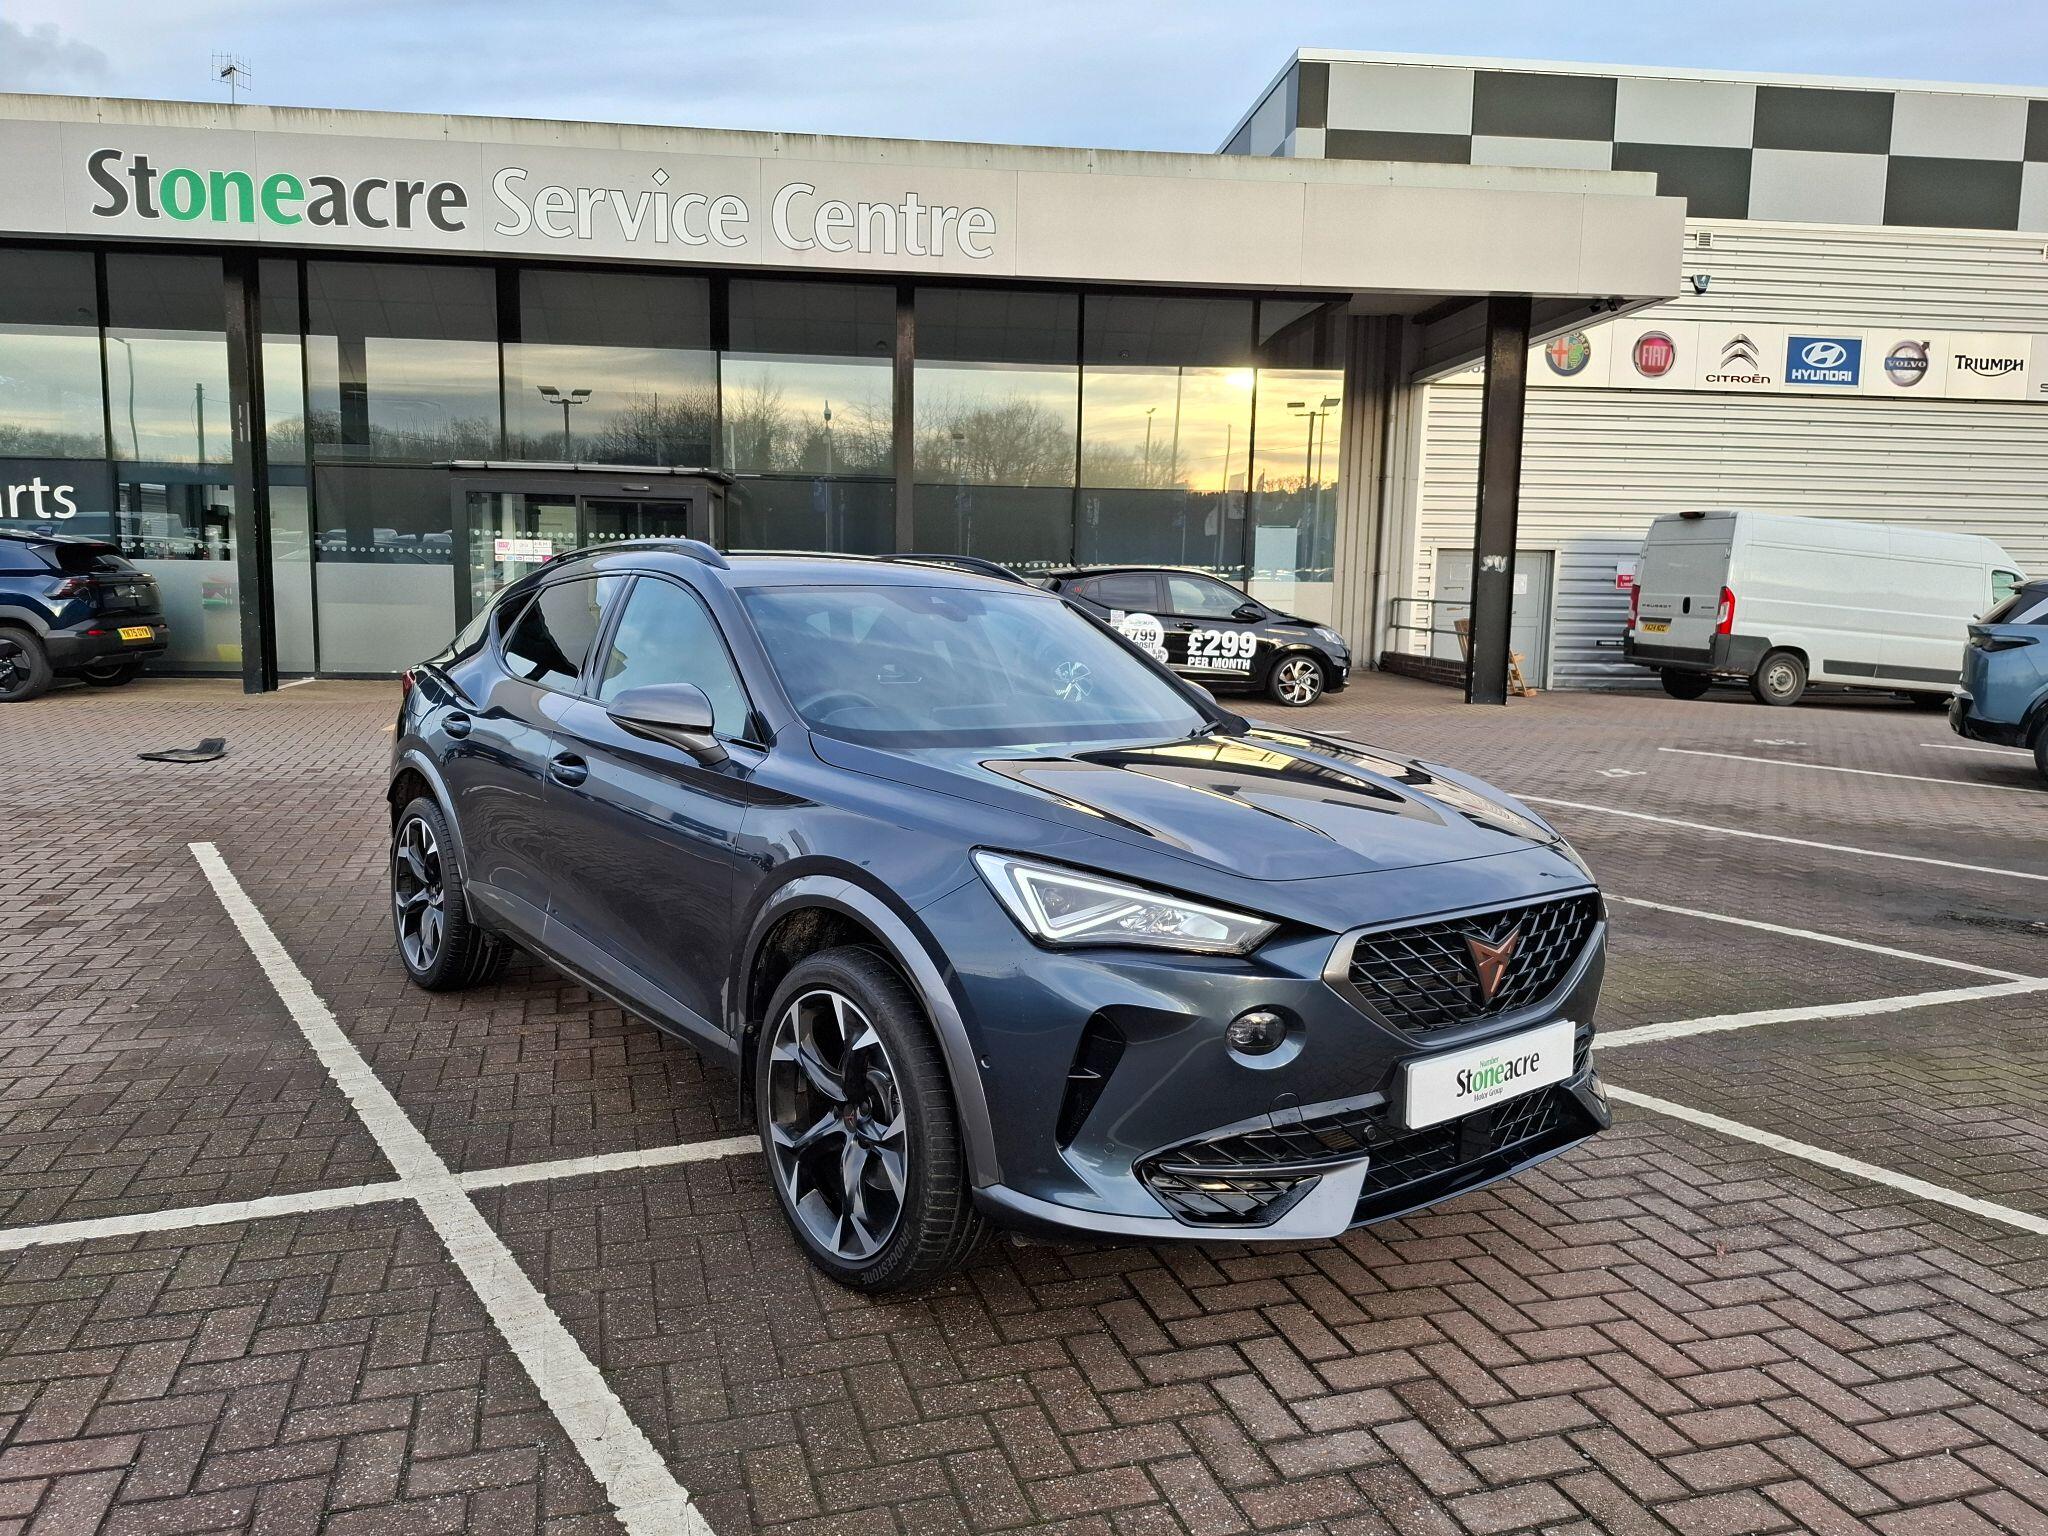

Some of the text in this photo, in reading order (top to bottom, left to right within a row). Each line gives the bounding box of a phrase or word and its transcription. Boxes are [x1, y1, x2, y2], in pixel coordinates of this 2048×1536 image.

[87, 148, 997, 259] Stoneacre Service Centre
[1641, 345, 1668, 367] FIAT
[1887, 359, 1927, 368] VOLVO
[1954, 354, 2024, 376] TRIUMPH
[1791, 368, 1852, 382] HYUNDAI
[0, 476, 77, 519] rts
[1124, 628, 1157, 642] £799
[1187, 629, 1257, 659] £299
[1187, 656, 1251, 670] PER MONTH
[1456, 1052, 1540, 1098] Stoneacre
[1473, 1086, 1504, 1102] Motor Group
[861, 1220, 913, 1285] BRIDGESTONE
